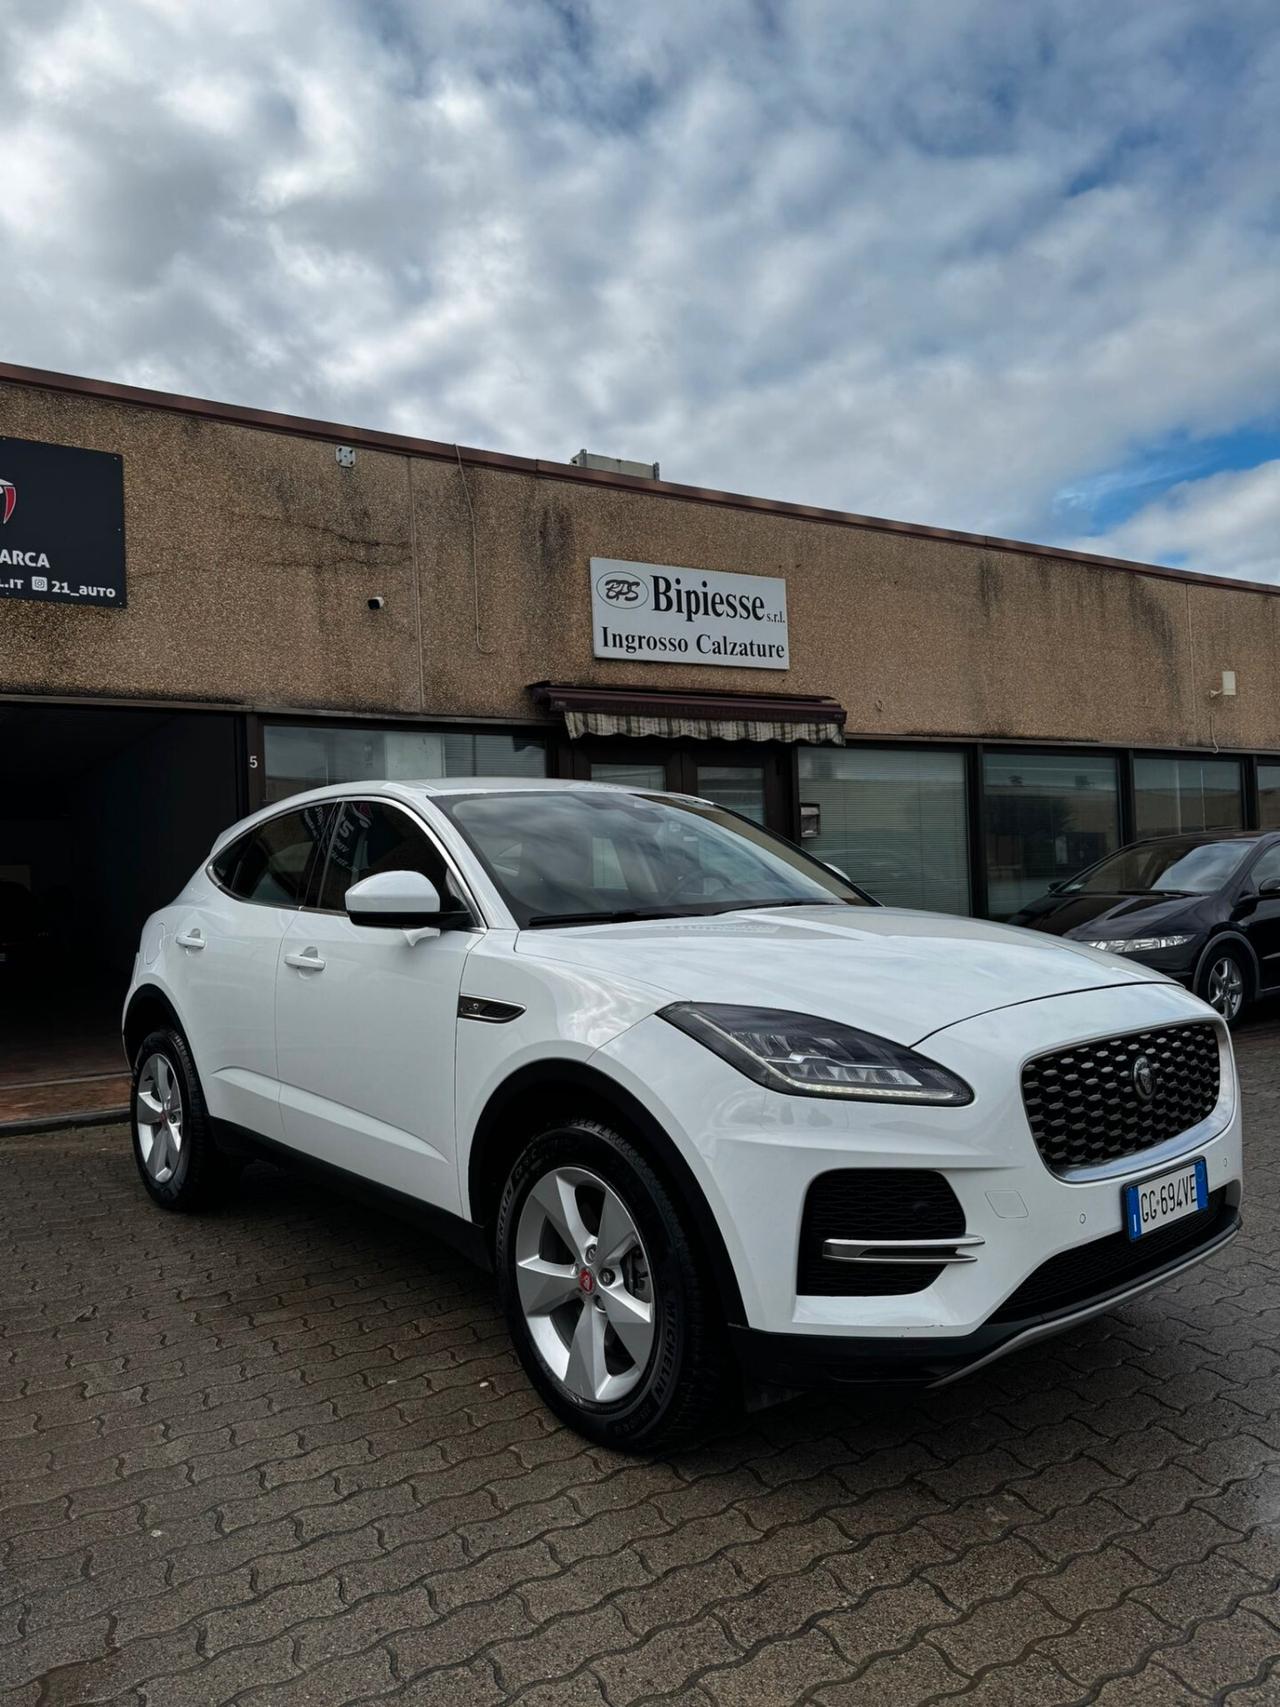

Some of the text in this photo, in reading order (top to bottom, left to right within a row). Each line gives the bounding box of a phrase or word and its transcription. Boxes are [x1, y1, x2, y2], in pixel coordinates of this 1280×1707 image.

[650, 575, 786, 624] Bipiesse s.r.l.
[602, 626, 785, 659] Ingrosso Calzature
[249, 755, 258, 769] 5
